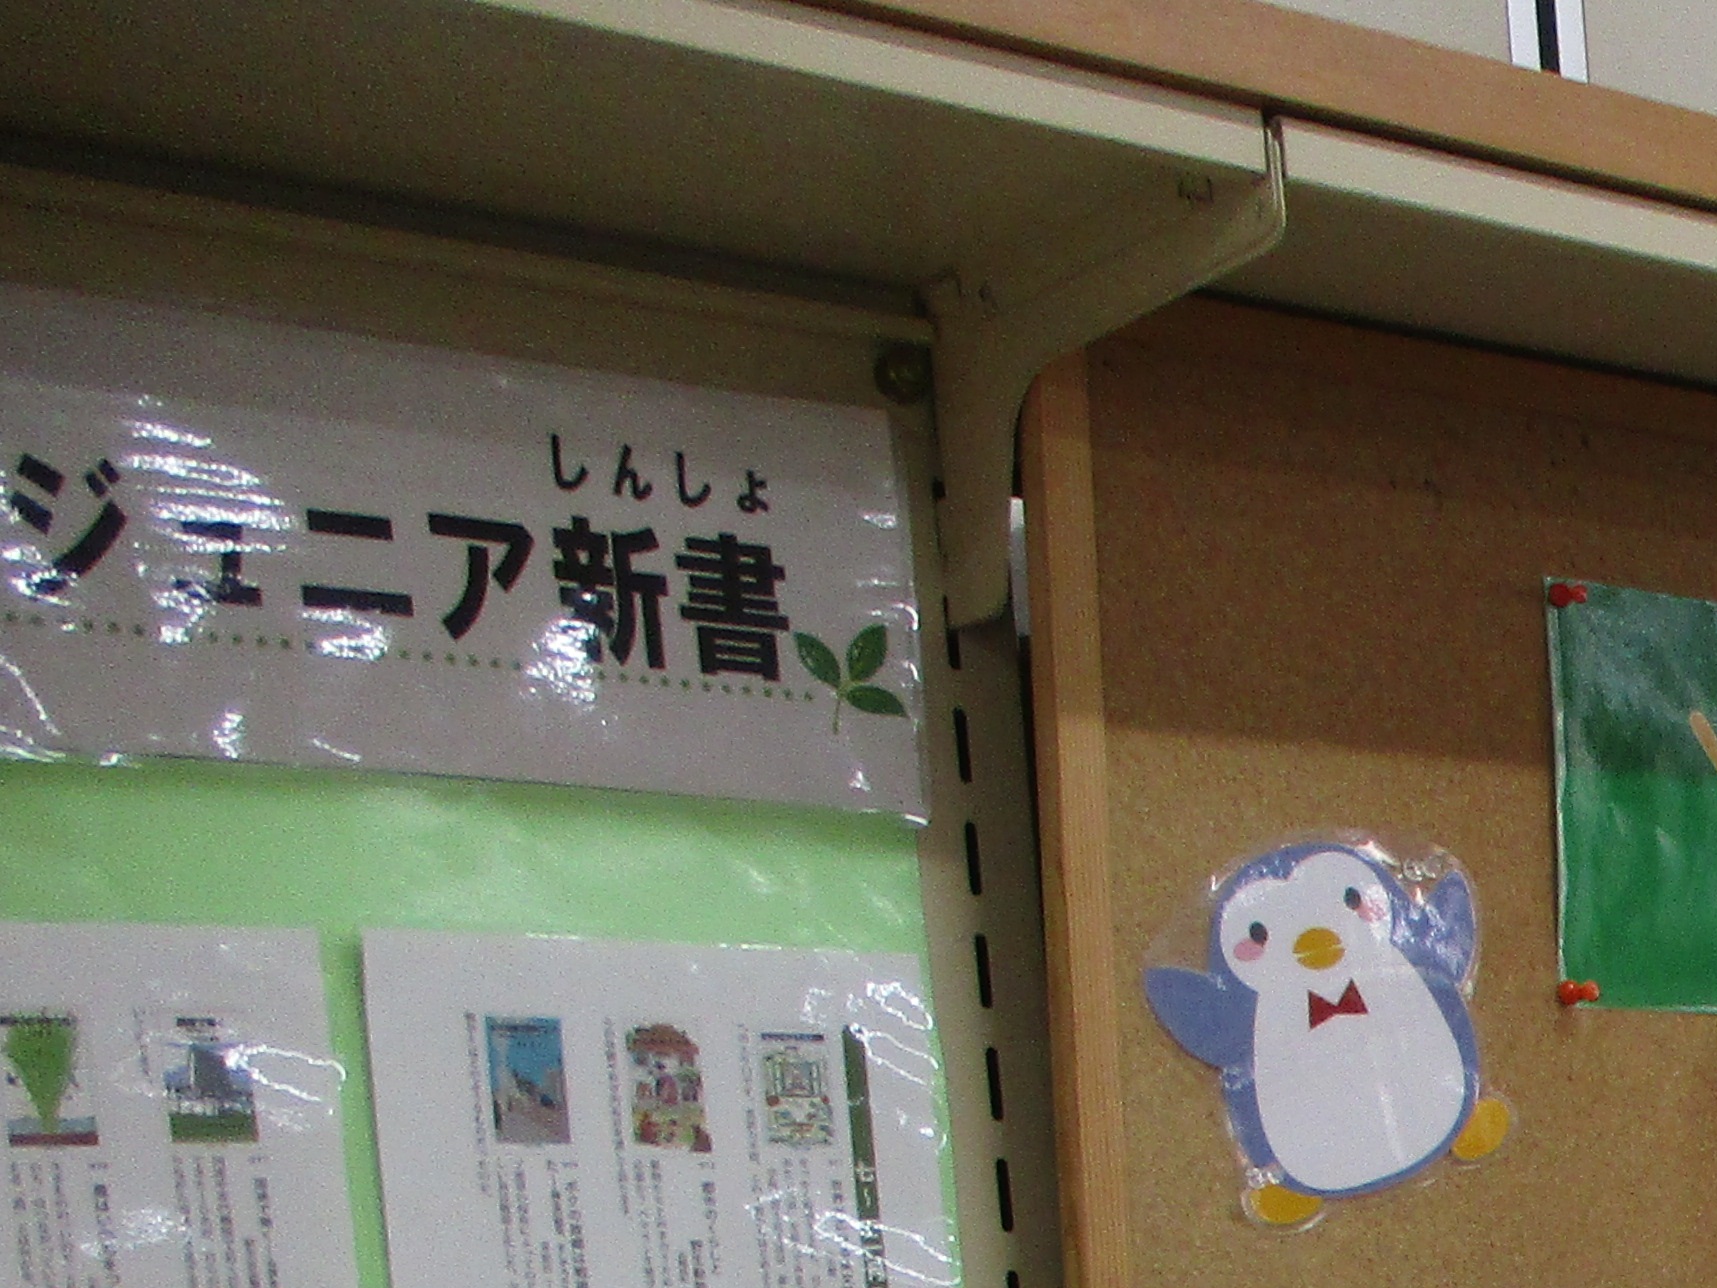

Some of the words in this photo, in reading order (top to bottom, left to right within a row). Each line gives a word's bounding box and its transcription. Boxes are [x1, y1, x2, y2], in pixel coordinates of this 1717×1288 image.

[550, 434, 770, 513] しんしょ
[12, 456, 789, 681] ジュニア新書
